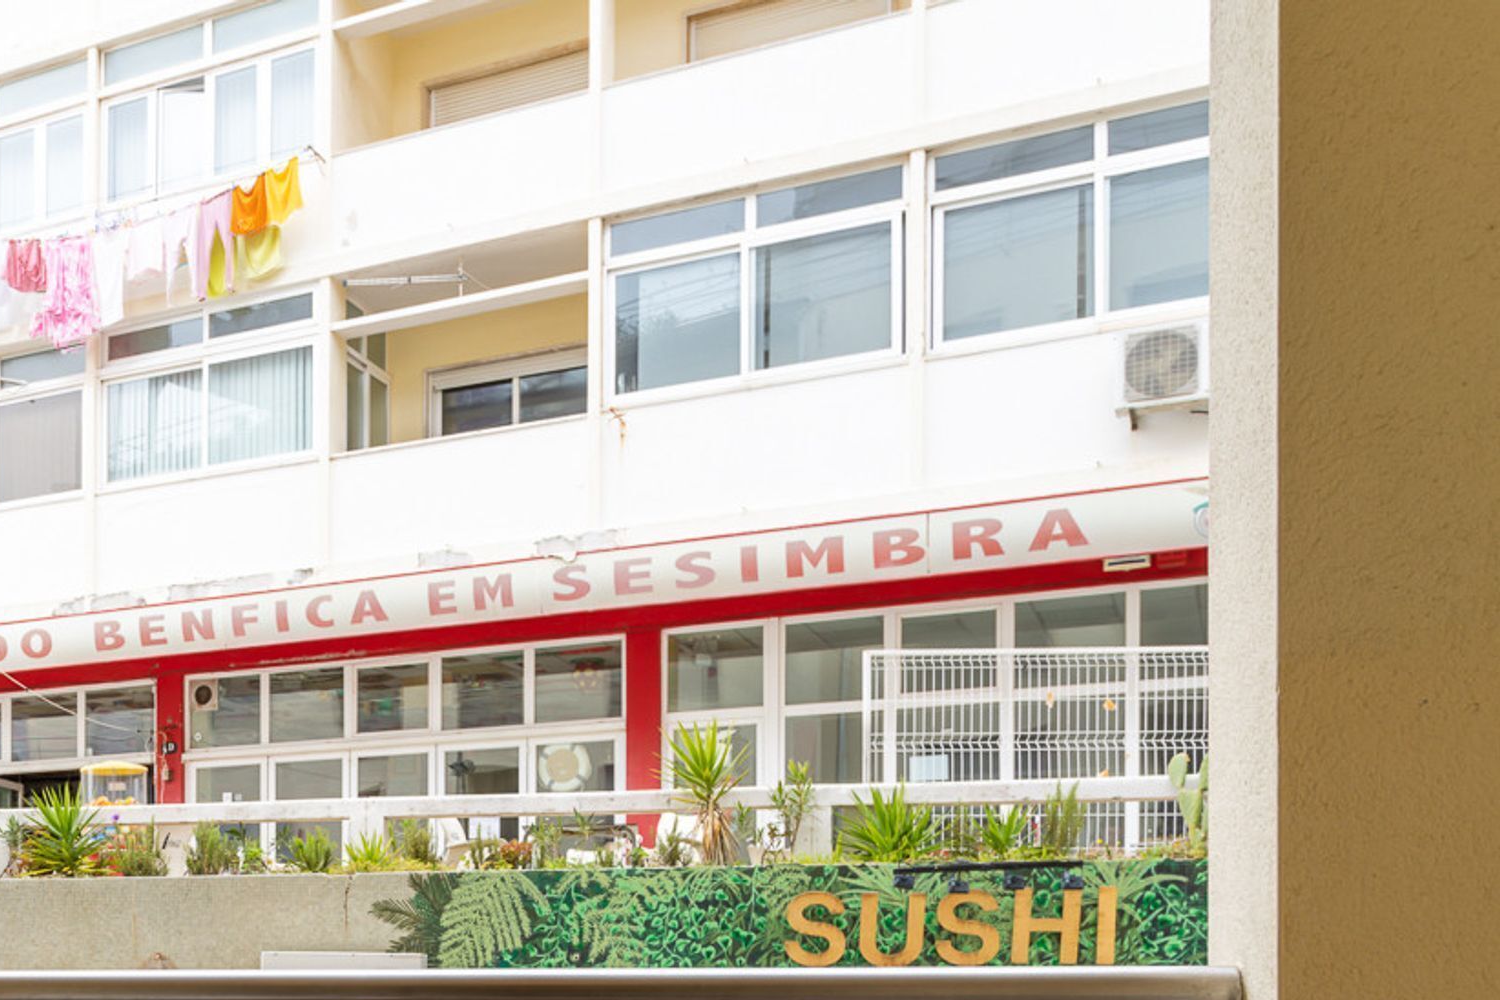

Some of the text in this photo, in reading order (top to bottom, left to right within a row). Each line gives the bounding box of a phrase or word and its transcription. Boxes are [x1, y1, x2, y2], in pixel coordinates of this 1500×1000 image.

[93, 589, 389, 652] BENFICA
[426, 573, 515, 616] EM
[552, 508, 1090, 602] SESIMBRA
[784, 885, 1118, 967] SUSHI
